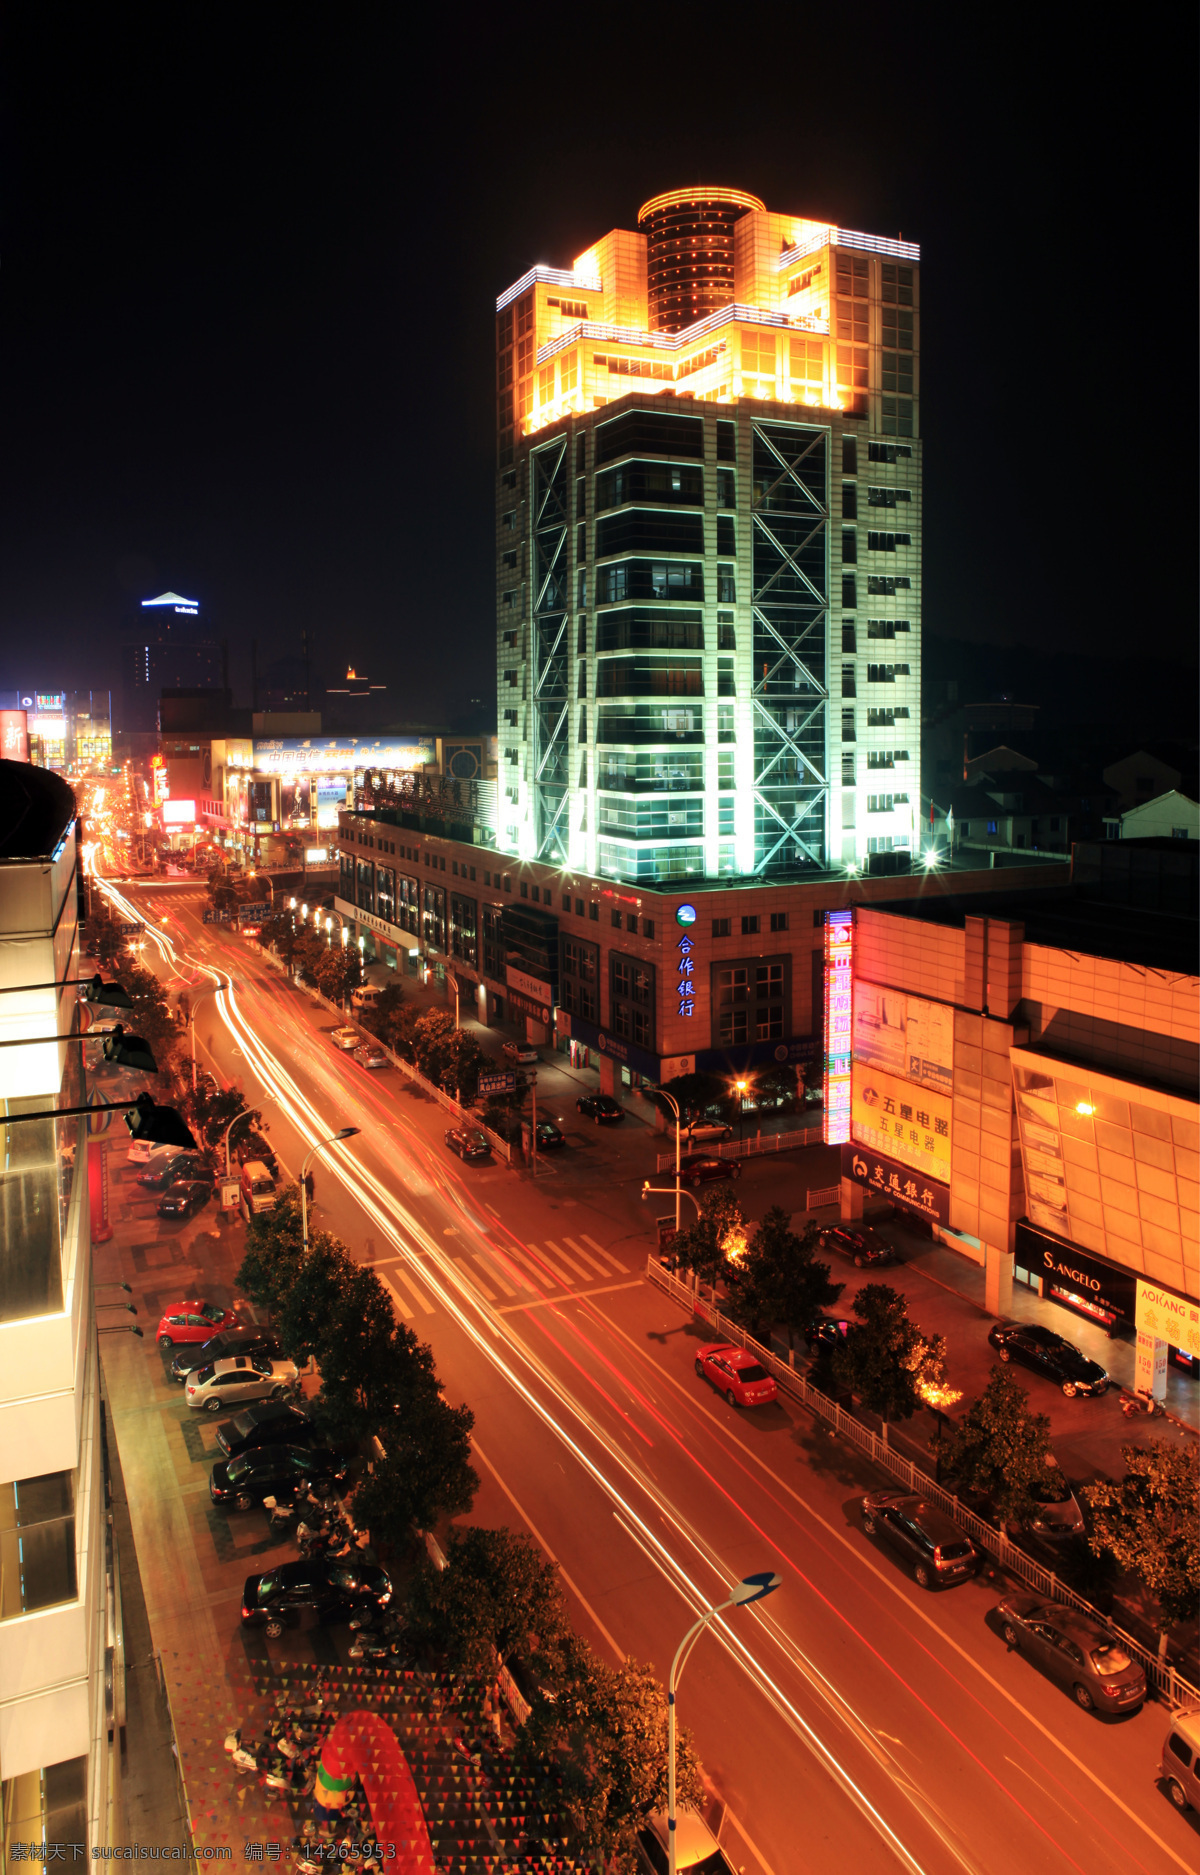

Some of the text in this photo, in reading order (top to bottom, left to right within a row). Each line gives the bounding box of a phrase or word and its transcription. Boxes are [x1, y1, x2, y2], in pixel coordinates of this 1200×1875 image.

[4, 721, 23, 753] 新
[677, 934, 696, 1017] 合作银行
[883, 1096, 948, 1137] 五星电器
[880, 1116, 934, 1152] 五星电器
[868, 1178, 940, 1218] BANK OF COMMUNICATIONS
[1142, 1289, 1186, 1317] AOKANG
[1138, 1355, 1152, 1369] 150
[1155, 1358, 1166, 1371] 150
